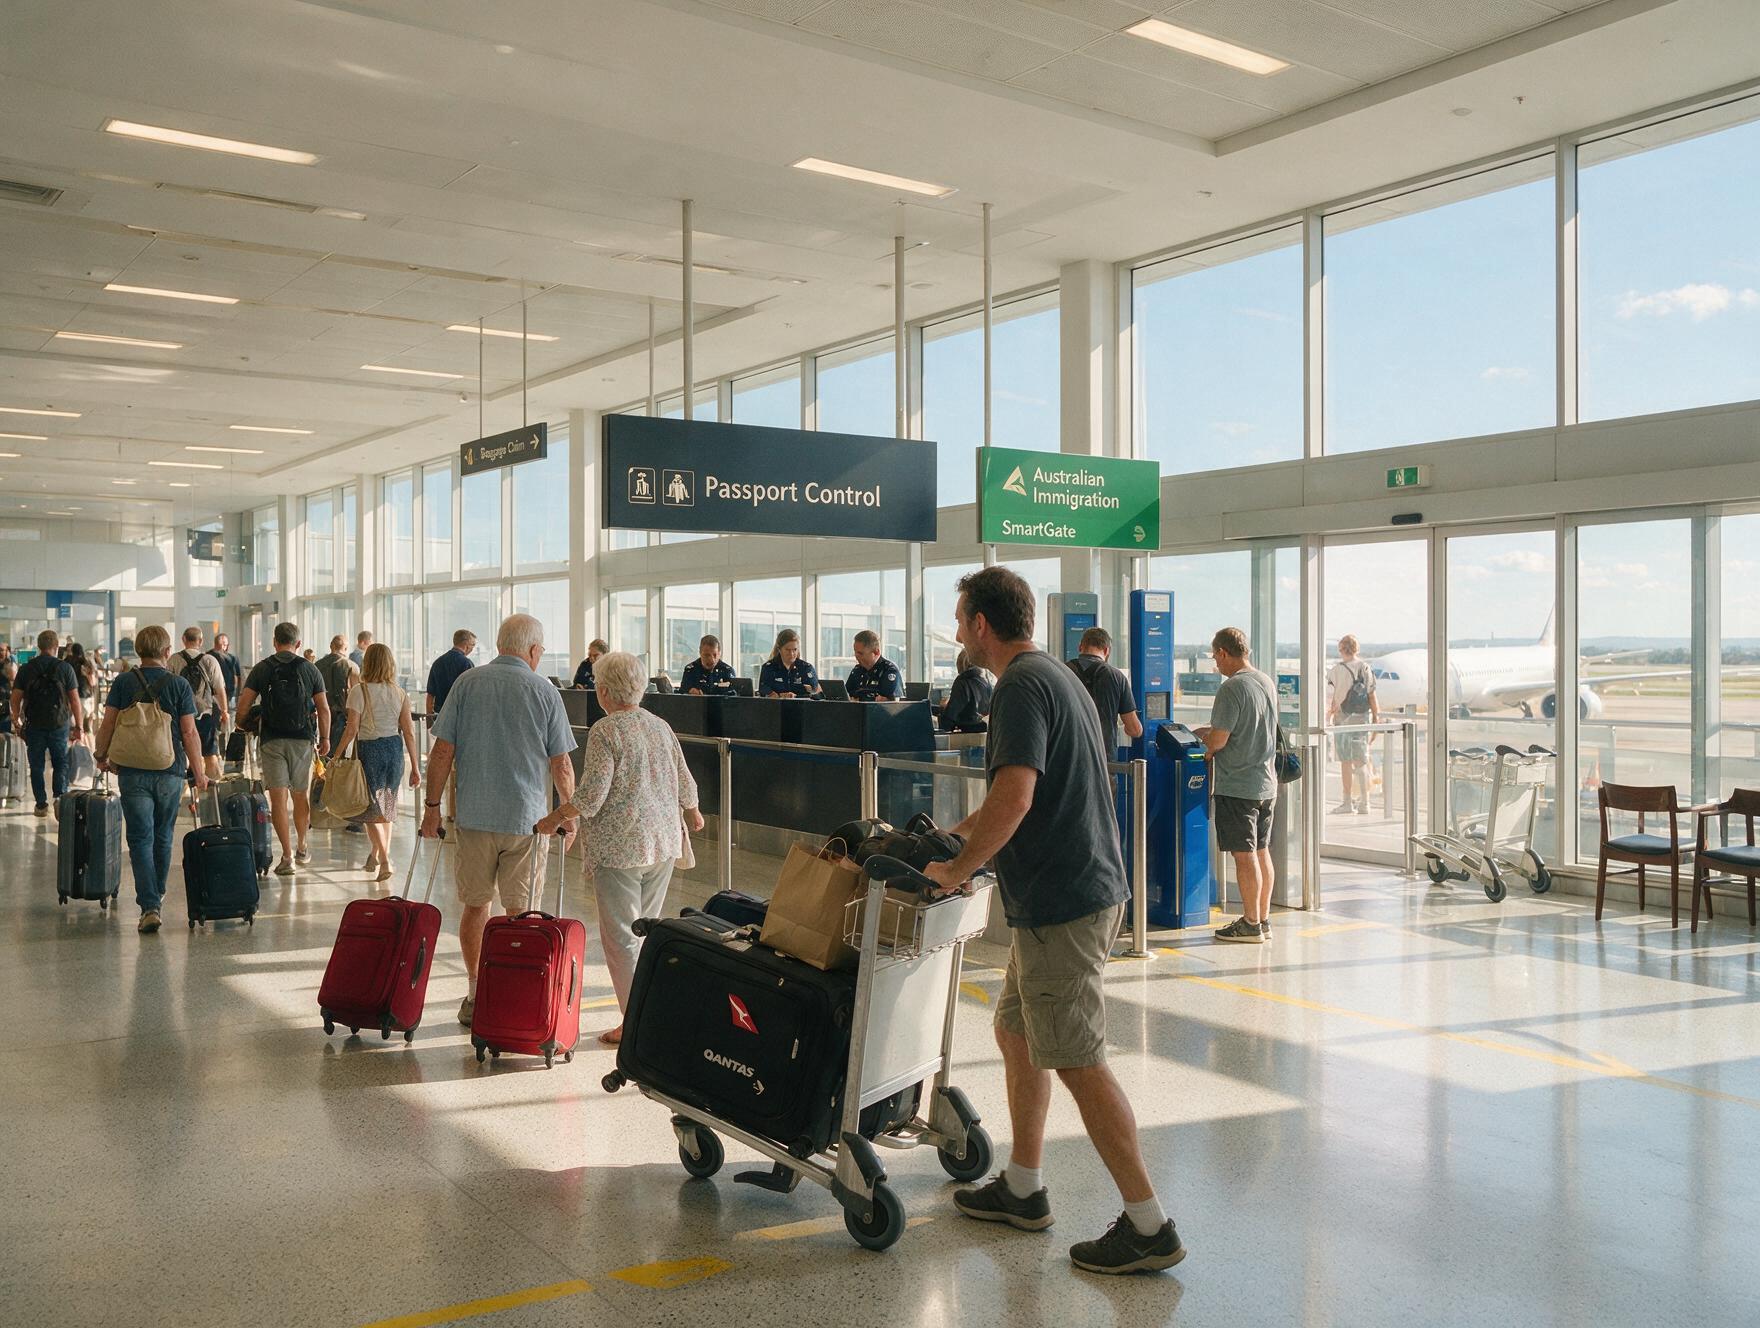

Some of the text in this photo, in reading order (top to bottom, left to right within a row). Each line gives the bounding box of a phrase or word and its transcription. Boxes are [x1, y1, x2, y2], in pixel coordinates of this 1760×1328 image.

[1033, 467, 1105, 487] Australian
[706, 476, 880, 507] Passport Control
[1033, 487, 1119, 510] Immigration
[1002, 519, 1077, 538] SmartGate
[703, 1048, 755, 1077] QANTAS
